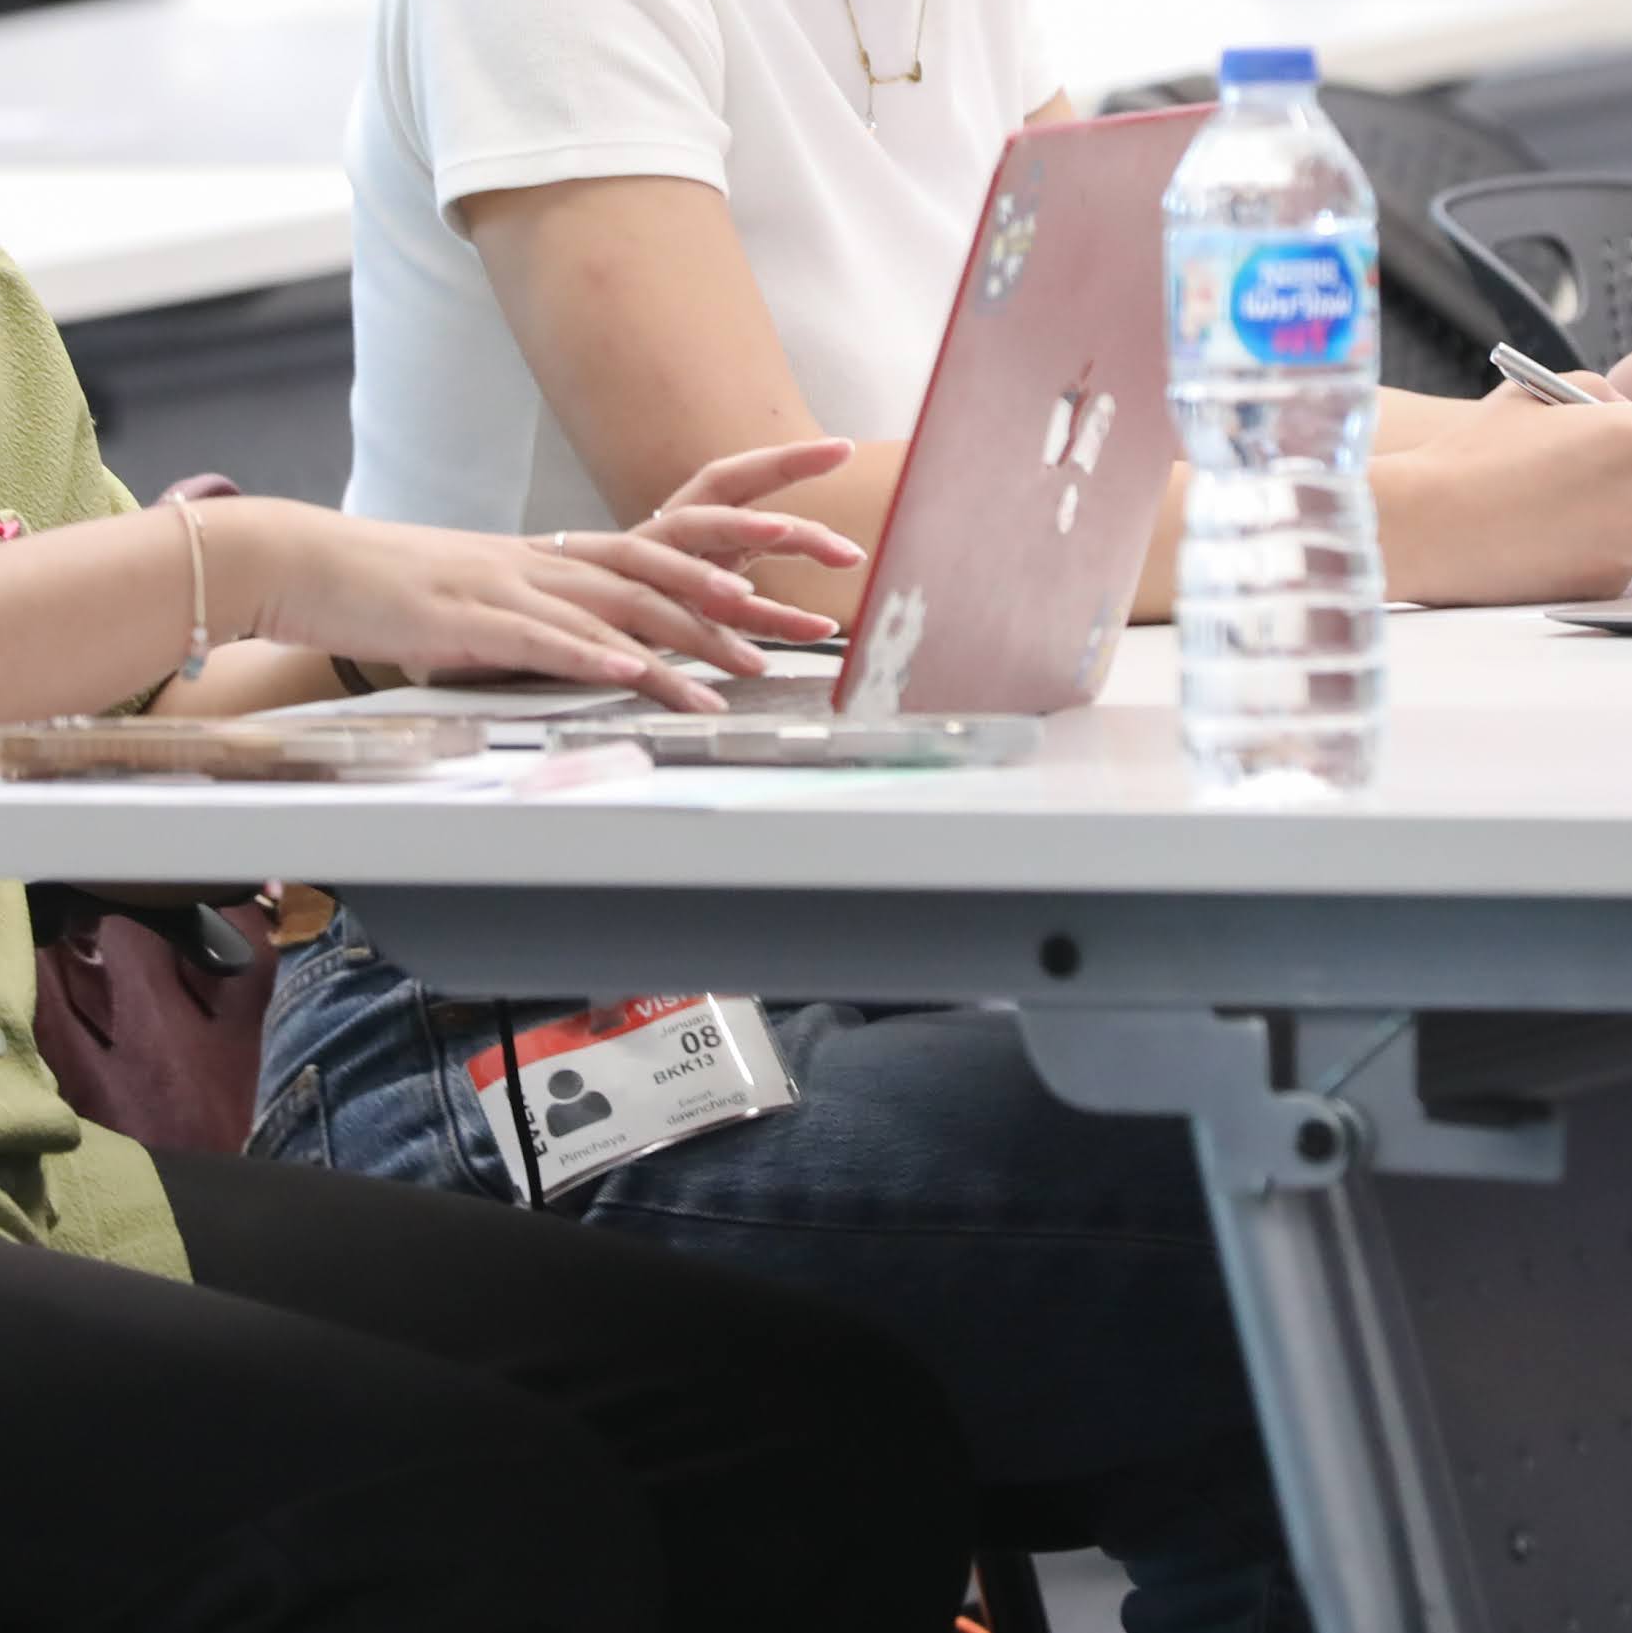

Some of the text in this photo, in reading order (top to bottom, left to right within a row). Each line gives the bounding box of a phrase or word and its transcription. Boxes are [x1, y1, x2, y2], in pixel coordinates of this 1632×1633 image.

[660, 1013, 713, 1038] January
[681, 1025, 721, 1054] 08
[653, 1053, 715, 1085] BKK13
